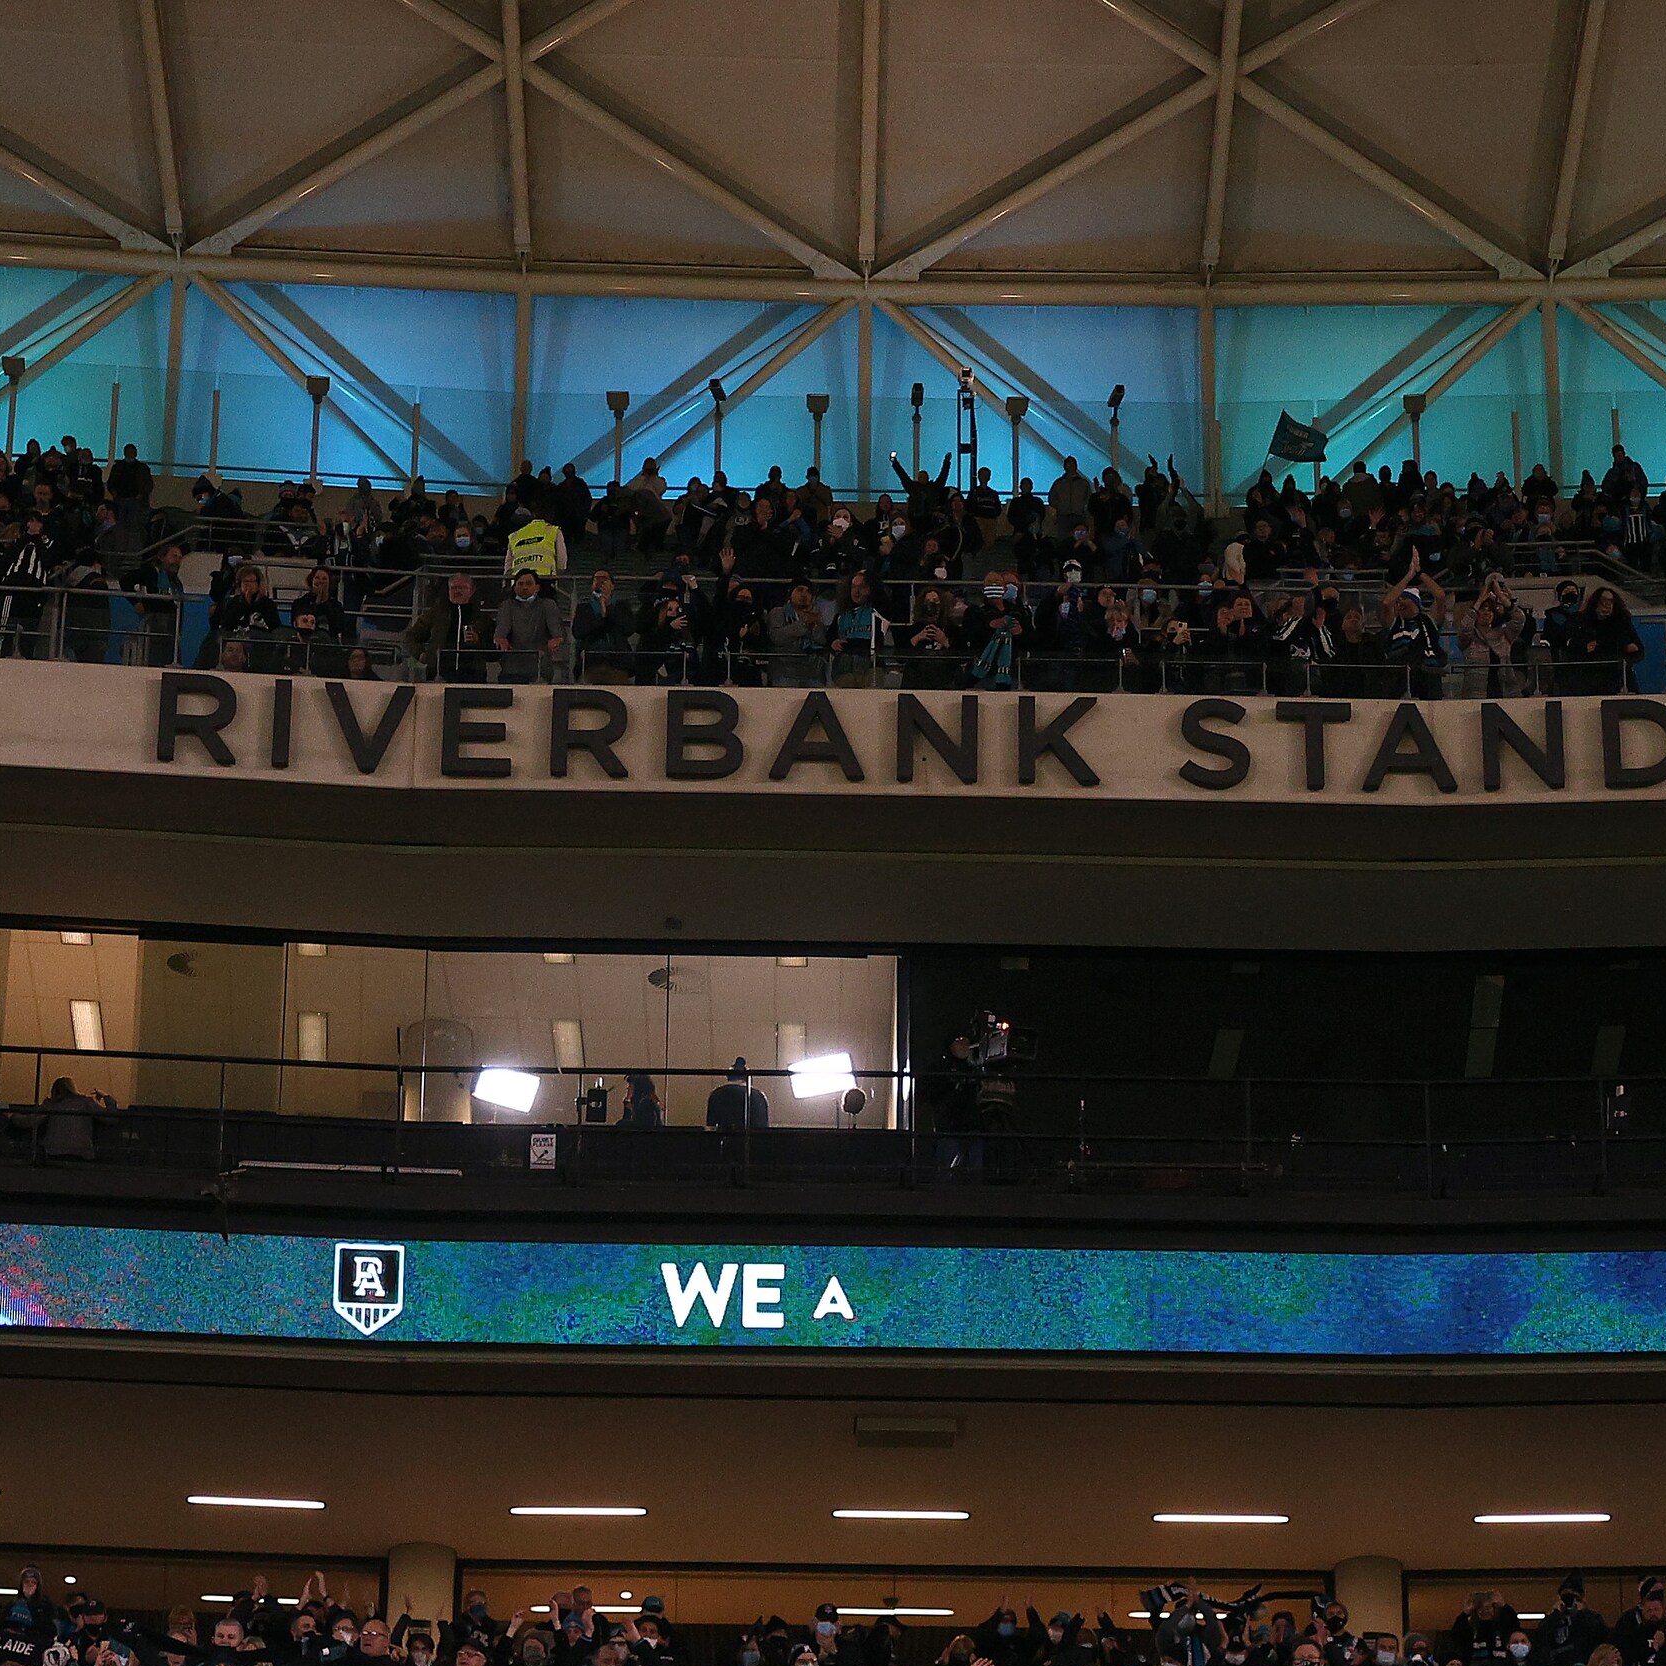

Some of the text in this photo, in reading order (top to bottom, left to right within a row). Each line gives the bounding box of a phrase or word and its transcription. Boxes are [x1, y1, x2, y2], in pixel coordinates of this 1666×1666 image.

[514, 554, 544, 566] SECURITY
[156, 673, 1103, 788] RIVERBANK
[661, 1262, 853, 1328] WE A
